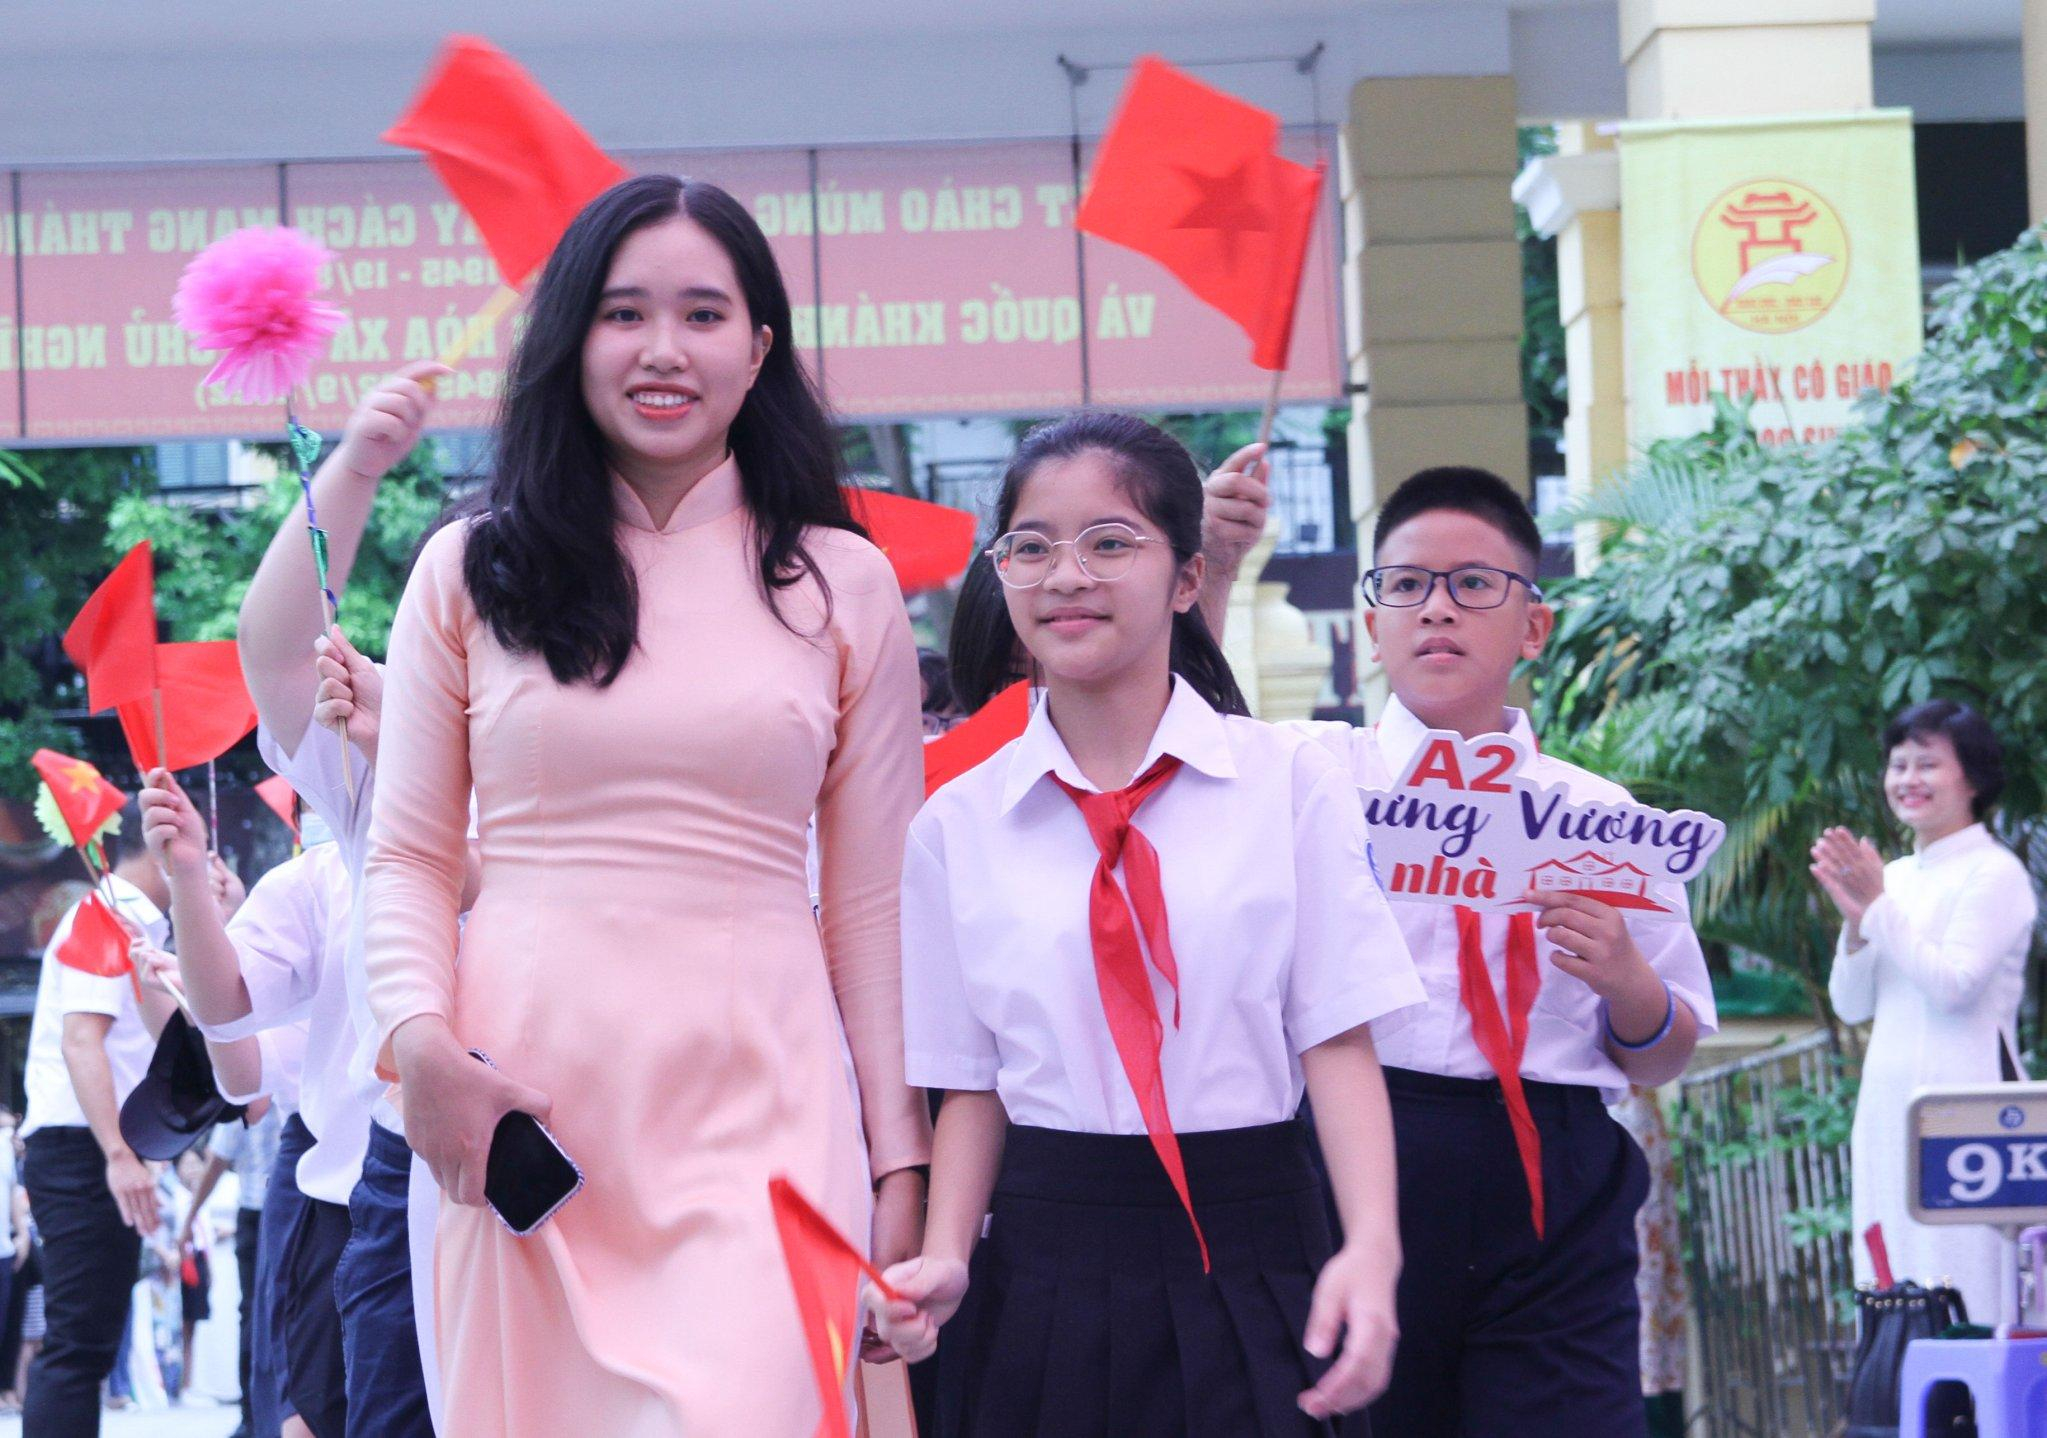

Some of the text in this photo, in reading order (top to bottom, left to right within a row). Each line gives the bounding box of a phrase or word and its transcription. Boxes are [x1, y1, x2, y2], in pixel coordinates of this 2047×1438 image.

[1793, 357, 1826, 400] CÔ
[1406, 738, 1517, 794] A2
[1520, 790, 1717, 875] Vương
[1389, 855, 1497, 899] nhà
